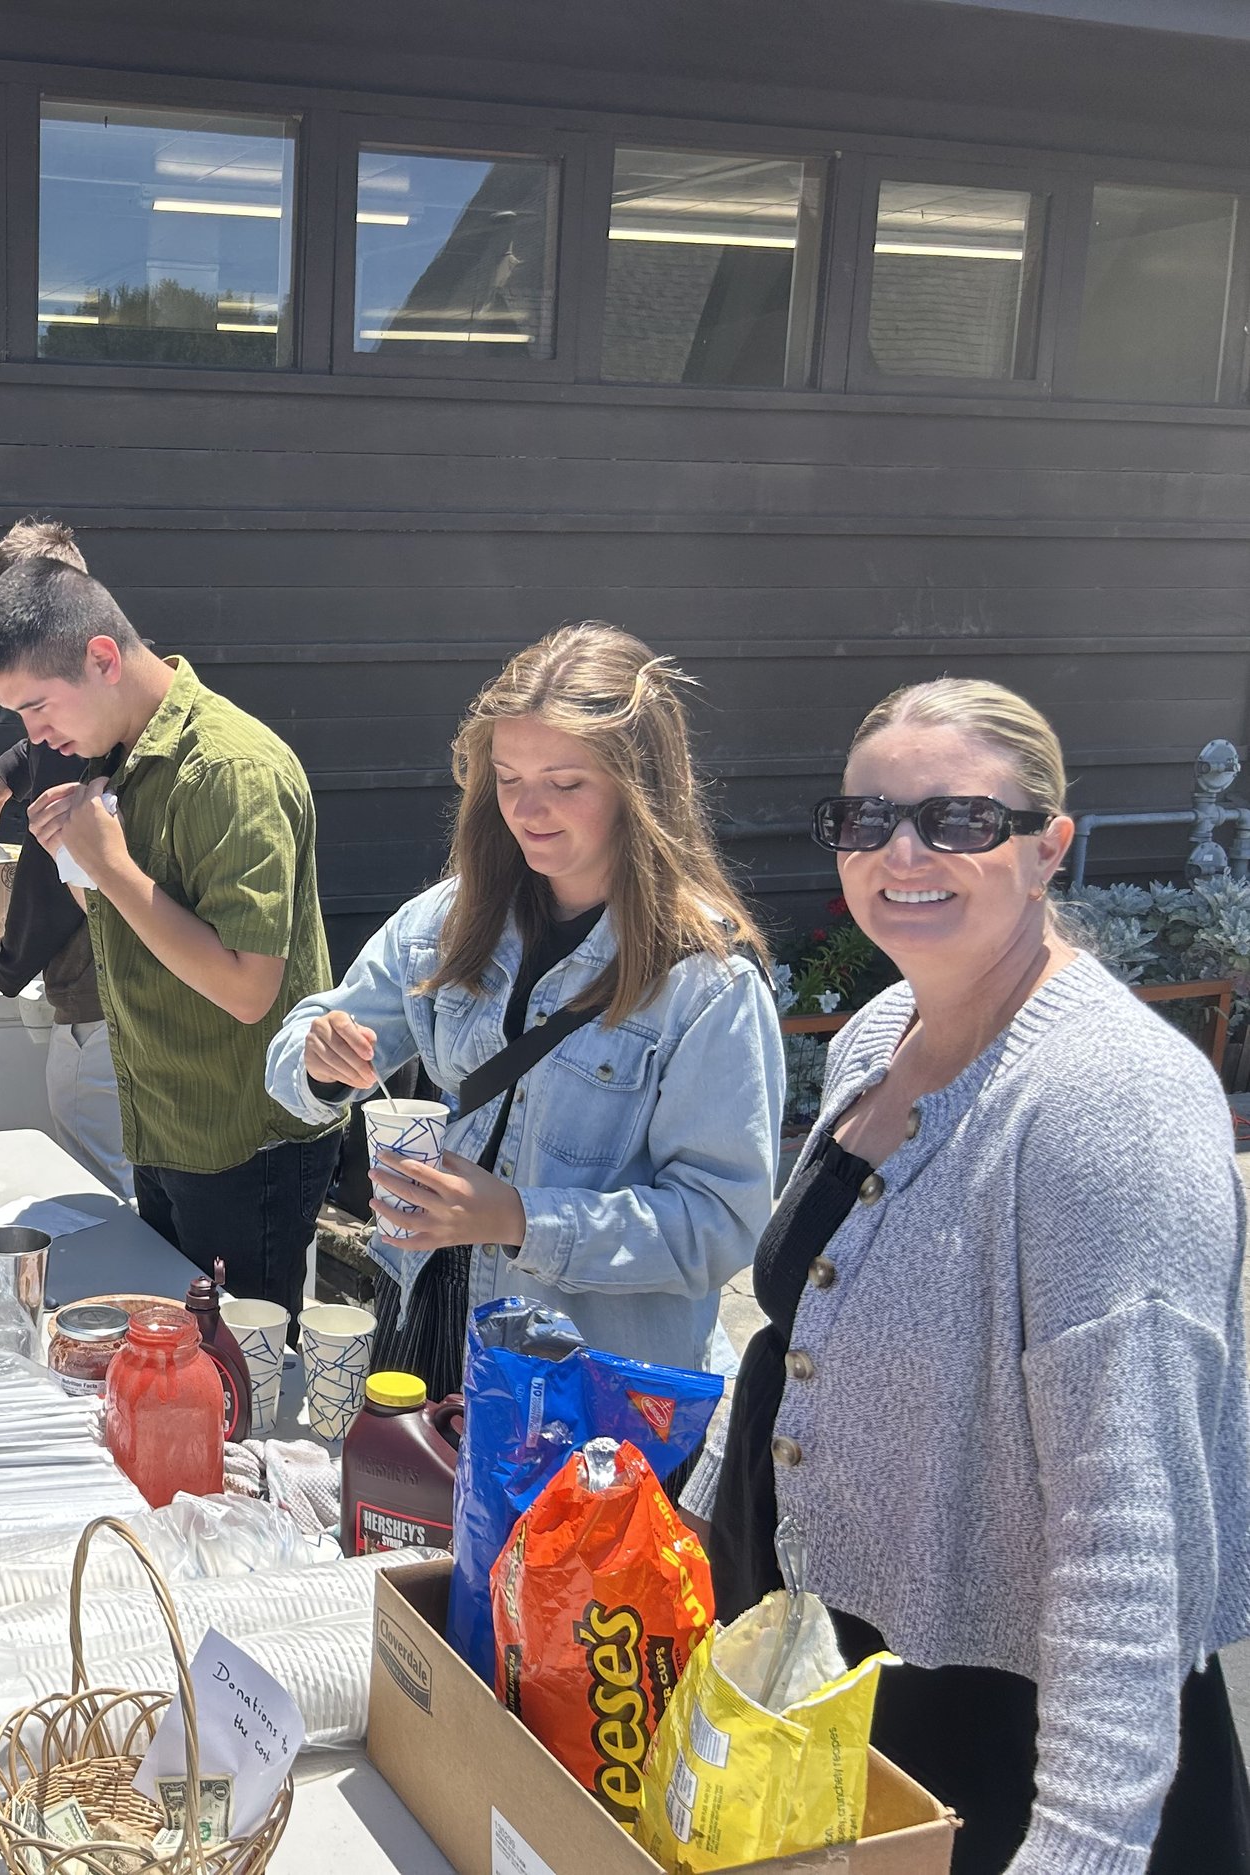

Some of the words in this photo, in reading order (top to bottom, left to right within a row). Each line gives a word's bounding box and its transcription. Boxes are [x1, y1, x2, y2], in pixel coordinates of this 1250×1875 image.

[644, 1397, 667, 1426] NABISCO
[362, 1509, 426, 1545] HERSHEY'S
[381, 1535, 404, 1550] SYRUP
[380, 1618, 428, 1687] Cloverdale
[508, 1651, 516, 1687] PEANUT
[655, 1646, 671, 1684] CUPS
[213, 1661, 278, 1737] Donations
[233, 1714, 248, 1738] the
[579, 1606, 646, 1834] eese's
